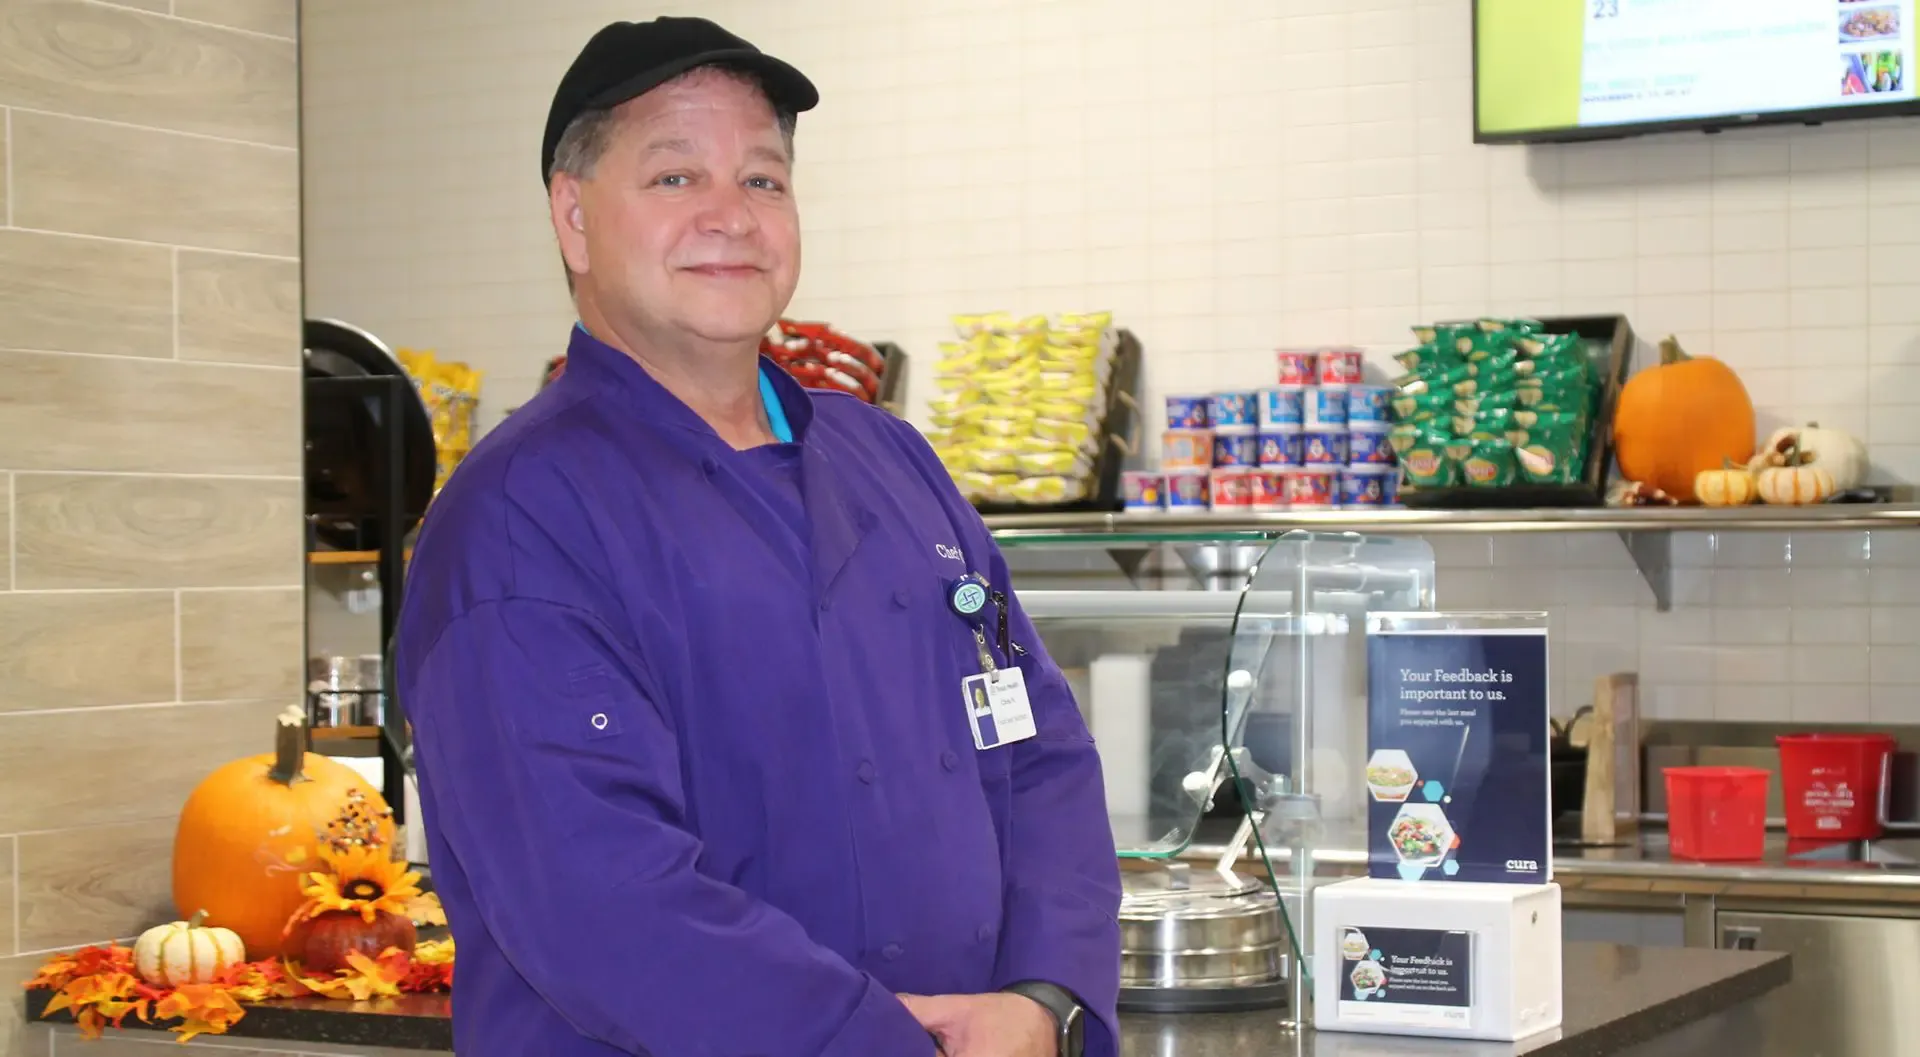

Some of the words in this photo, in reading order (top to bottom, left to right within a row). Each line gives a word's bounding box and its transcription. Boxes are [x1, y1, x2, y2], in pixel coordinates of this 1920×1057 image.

[1592, 0, 1619, 19] 23
[1400, 669, 1432, 682] Your
[1434, 668, 1498, 682] Feedback
[1500, 670, 1513, 682] is
[1400, 687, 1467, 703] important
[1469, 689, 1484, 700] to
[1486, 690, 1507, 700] us.
[1435, 708, 1446, 716] the
[1506, 859, 1538, 870] cura
[1391, 955, 1409, 964] Your
